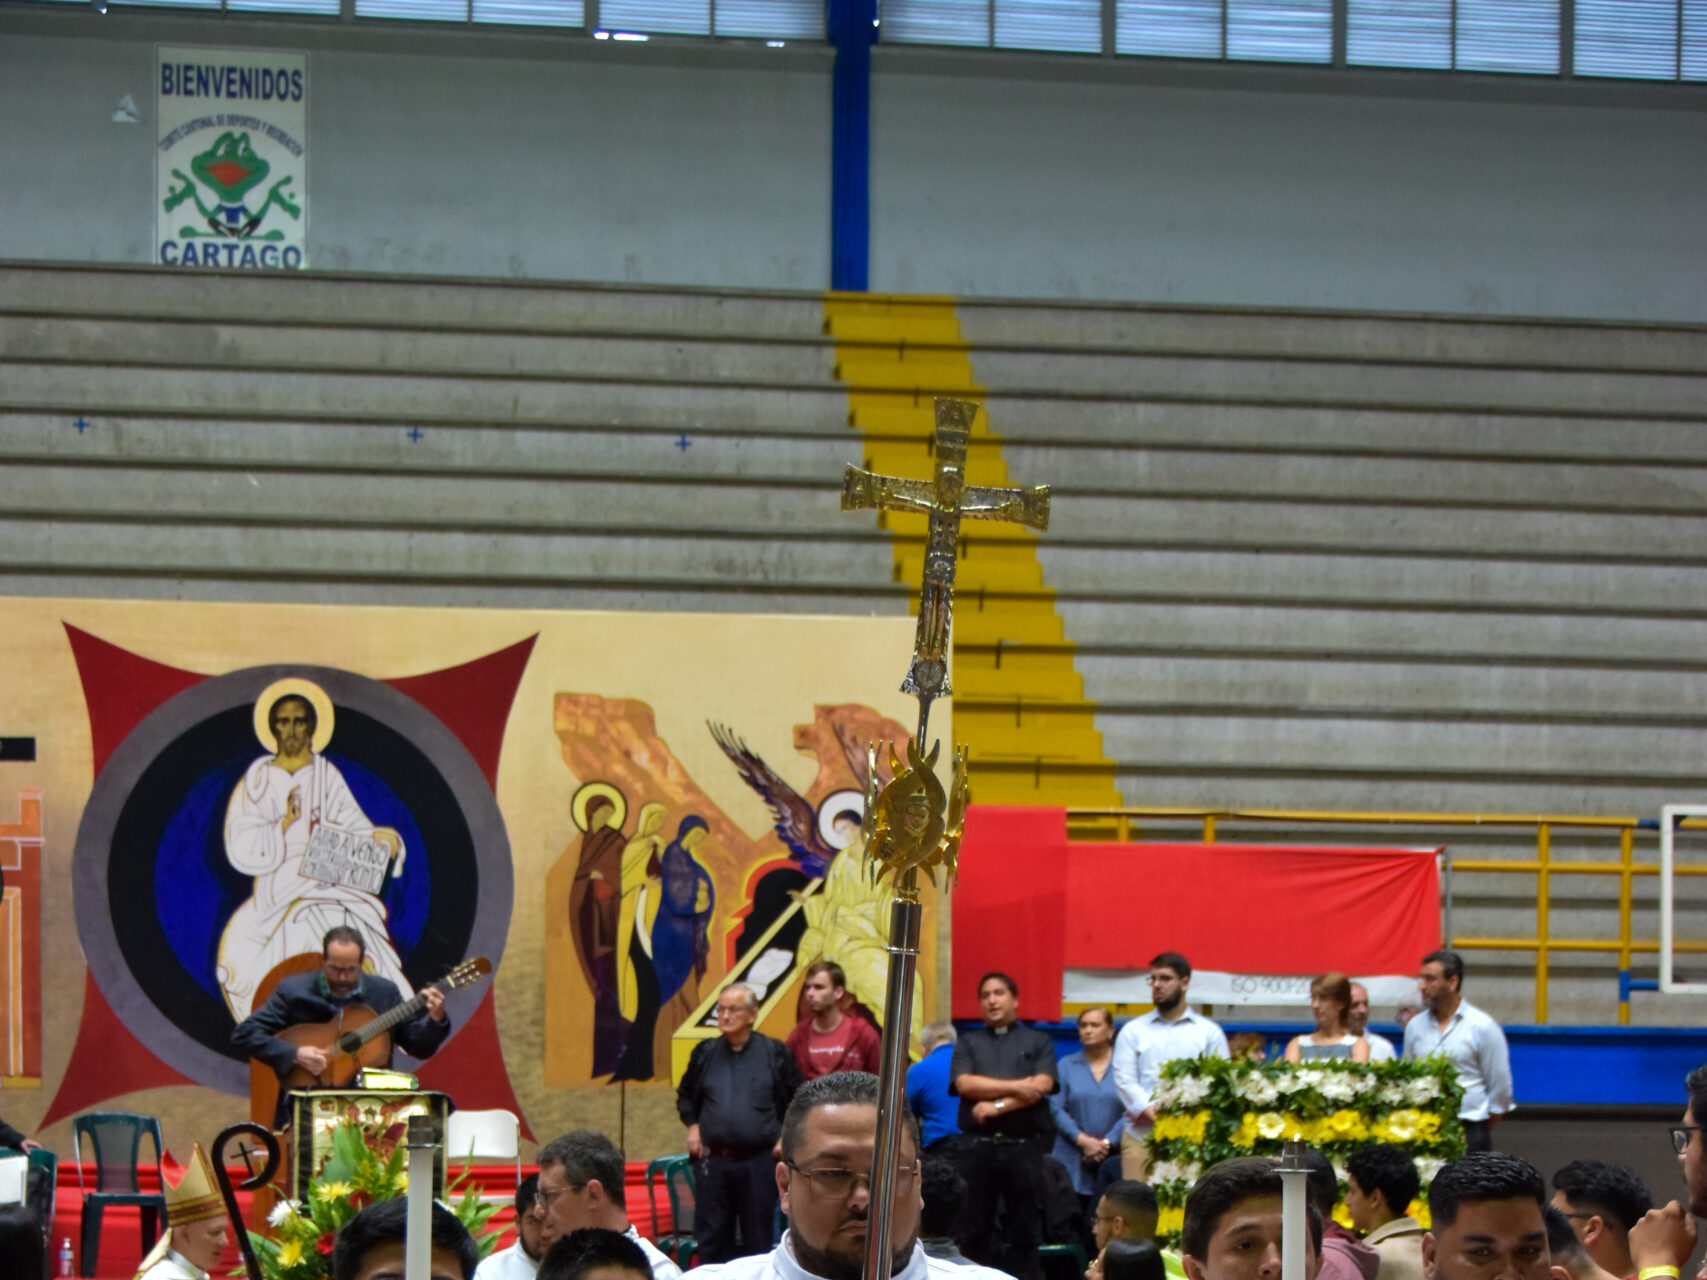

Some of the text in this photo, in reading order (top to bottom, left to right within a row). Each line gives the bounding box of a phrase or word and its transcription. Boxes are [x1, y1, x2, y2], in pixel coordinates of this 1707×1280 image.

[161, 62, 303, 102] BIENVENIDOS
[216, 113, 225, 128] DE
[160, 240, 302, 270] CARTAGO
